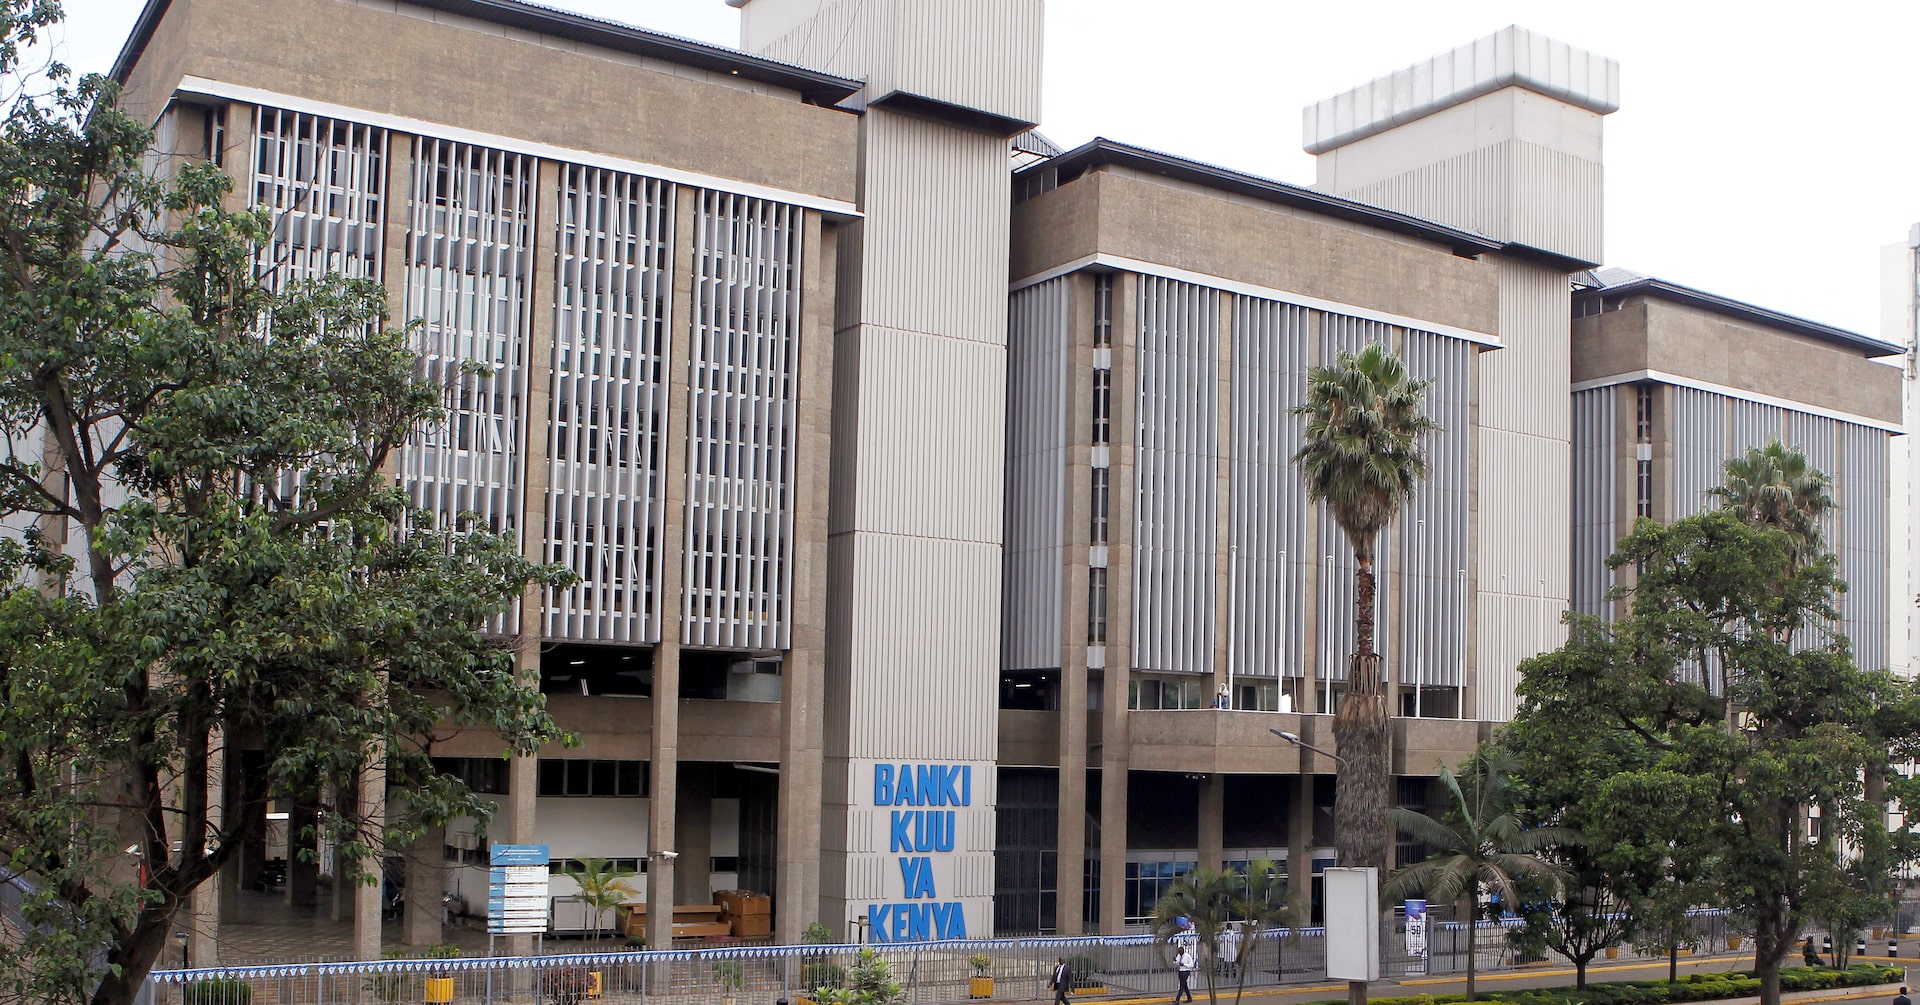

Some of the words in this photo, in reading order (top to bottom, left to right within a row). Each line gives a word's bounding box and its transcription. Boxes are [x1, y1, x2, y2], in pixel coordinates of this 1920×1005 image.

[874, 763, 971, 806] BANKI
[890, 810, 955, 853] KUU
[899, 857, 936, 898] YA
[868, 902, 967, 943] KENYA
